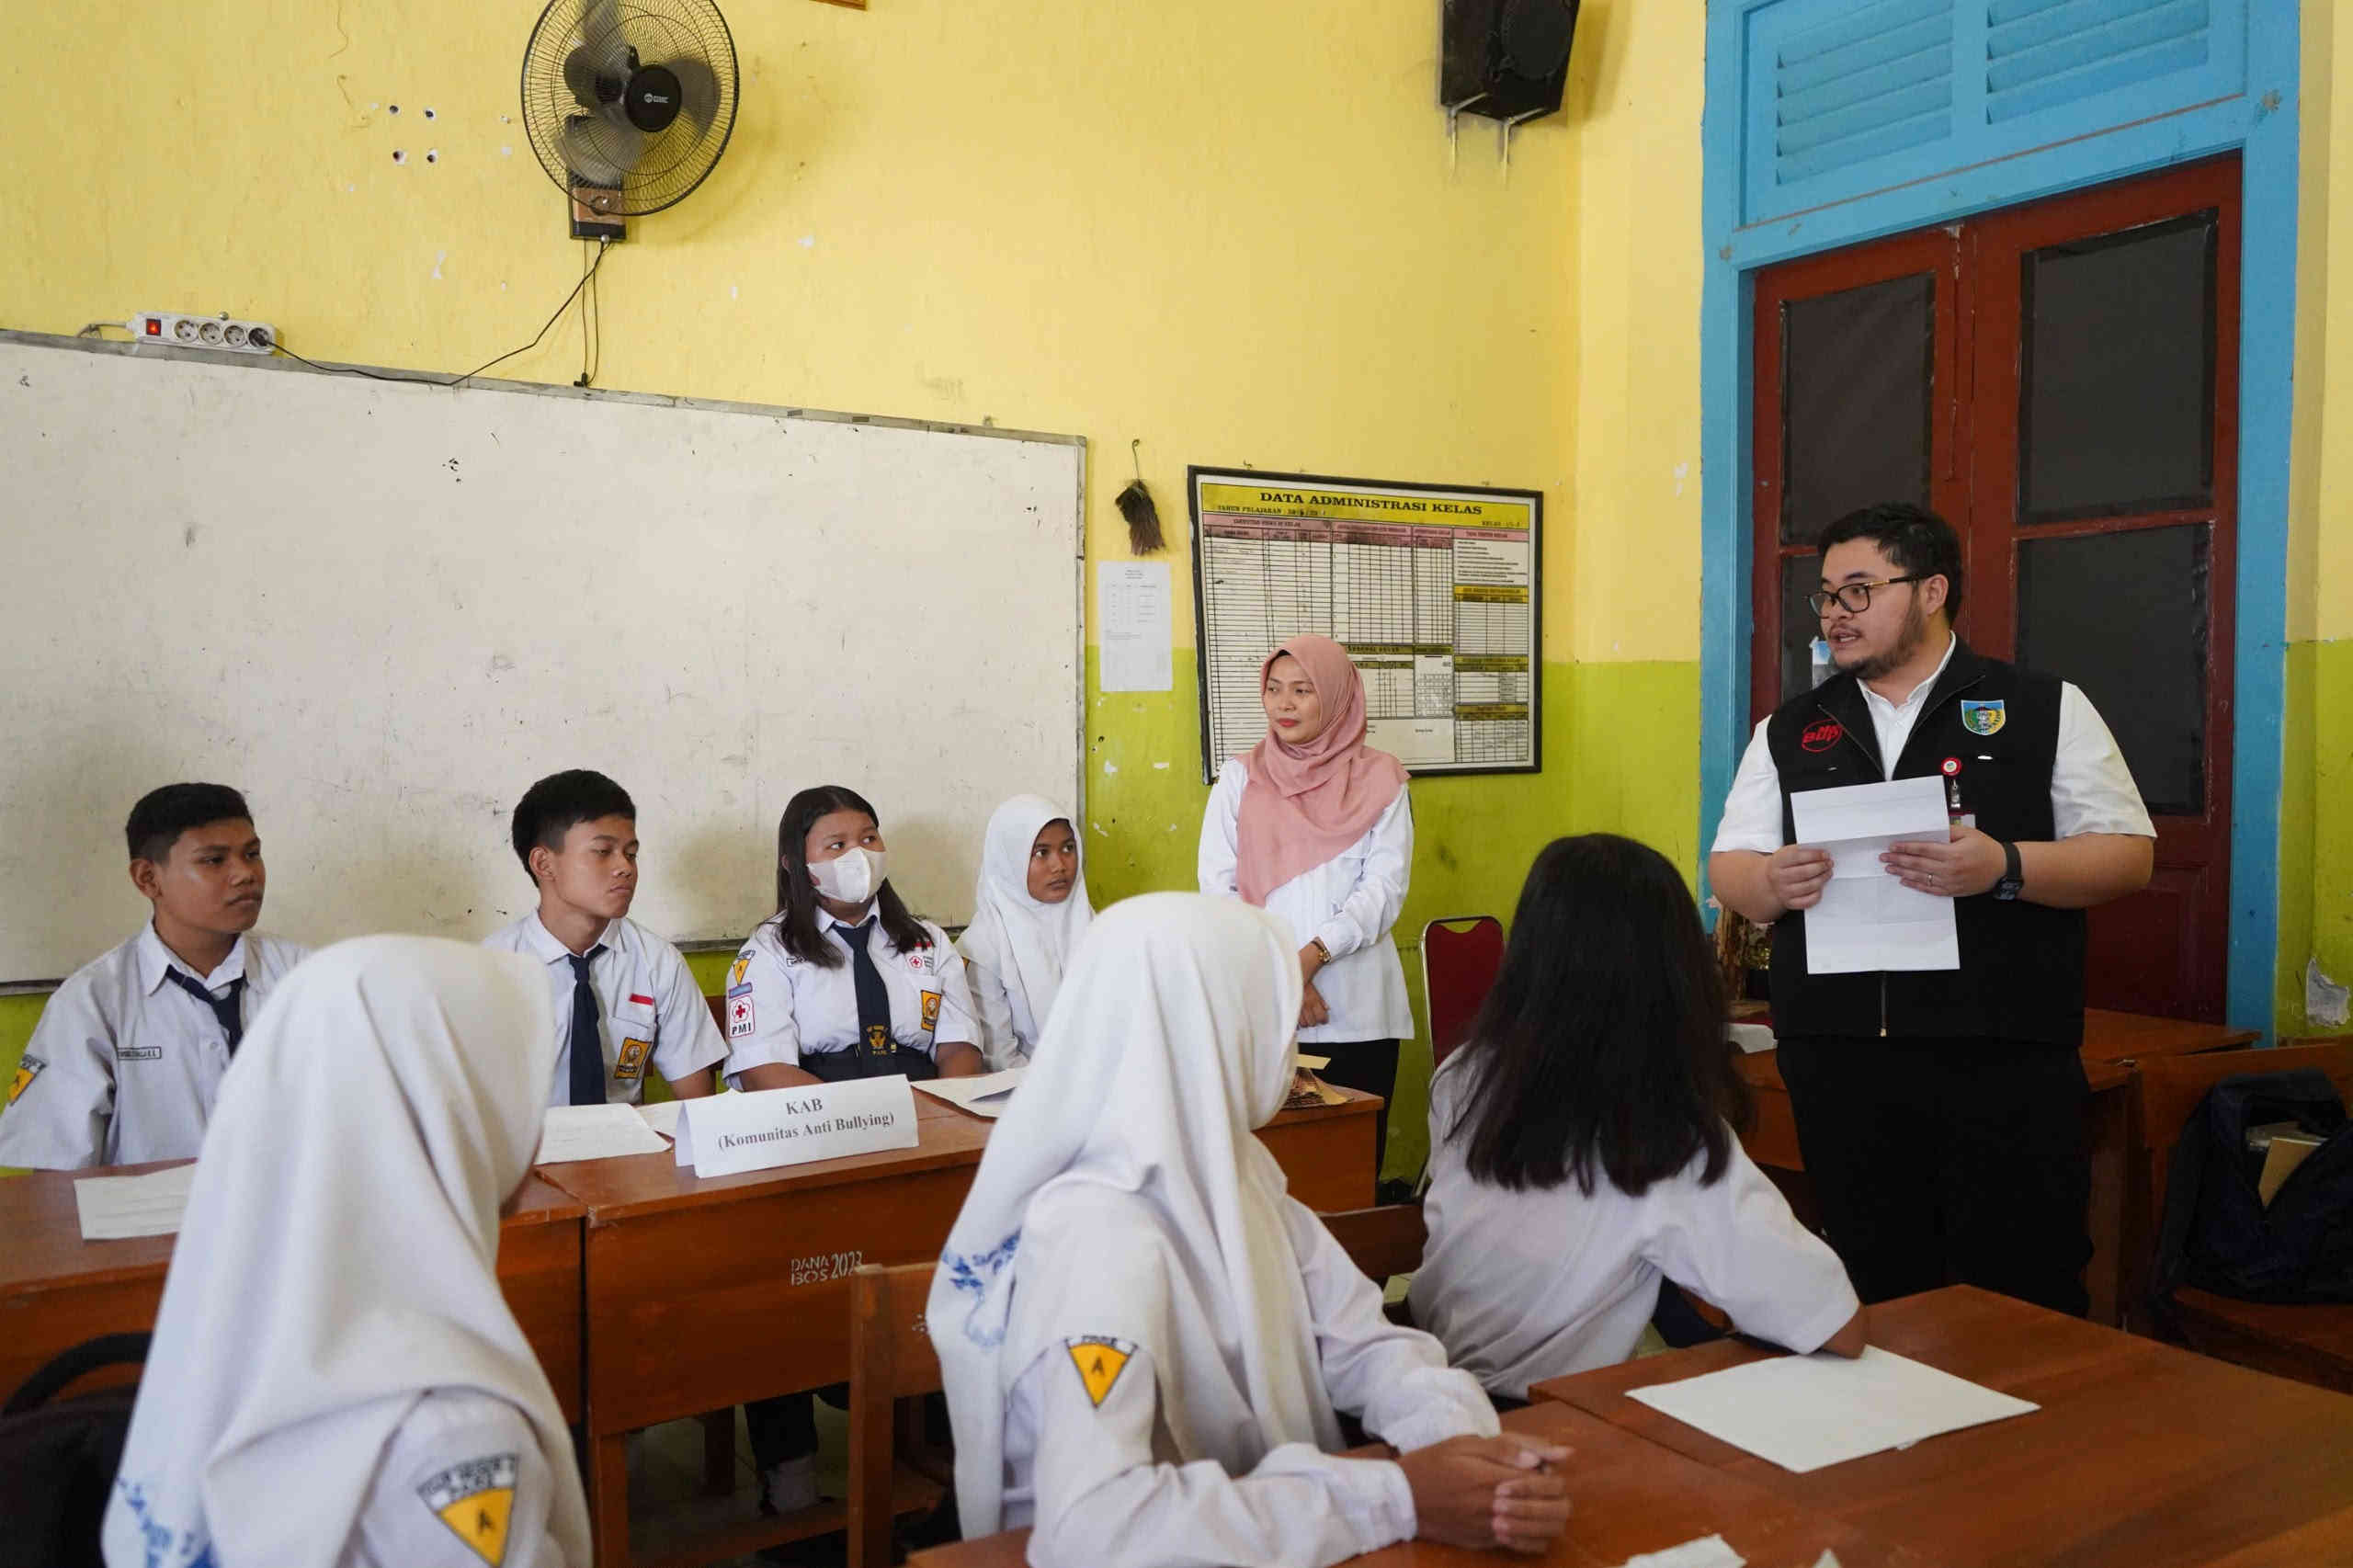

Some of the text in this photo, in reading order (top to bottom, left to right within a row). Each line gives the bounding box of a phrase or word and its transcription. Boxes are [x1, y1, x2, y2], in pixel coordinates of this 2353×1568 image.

[1260, 492, 1483, 515] DATA ADMINISTRASI KELAS
[732, 1022, 751, 1035] PMI
[786, 1097, 824, 1115] KAB
[718, 1112, 894, 1150] (Komunitas Anti Bullying)
[790, 1255, 830, 1272] DANA
[790, 1268, 828, 1286] BOS
[1091, 1357, 1105, 1376] A
